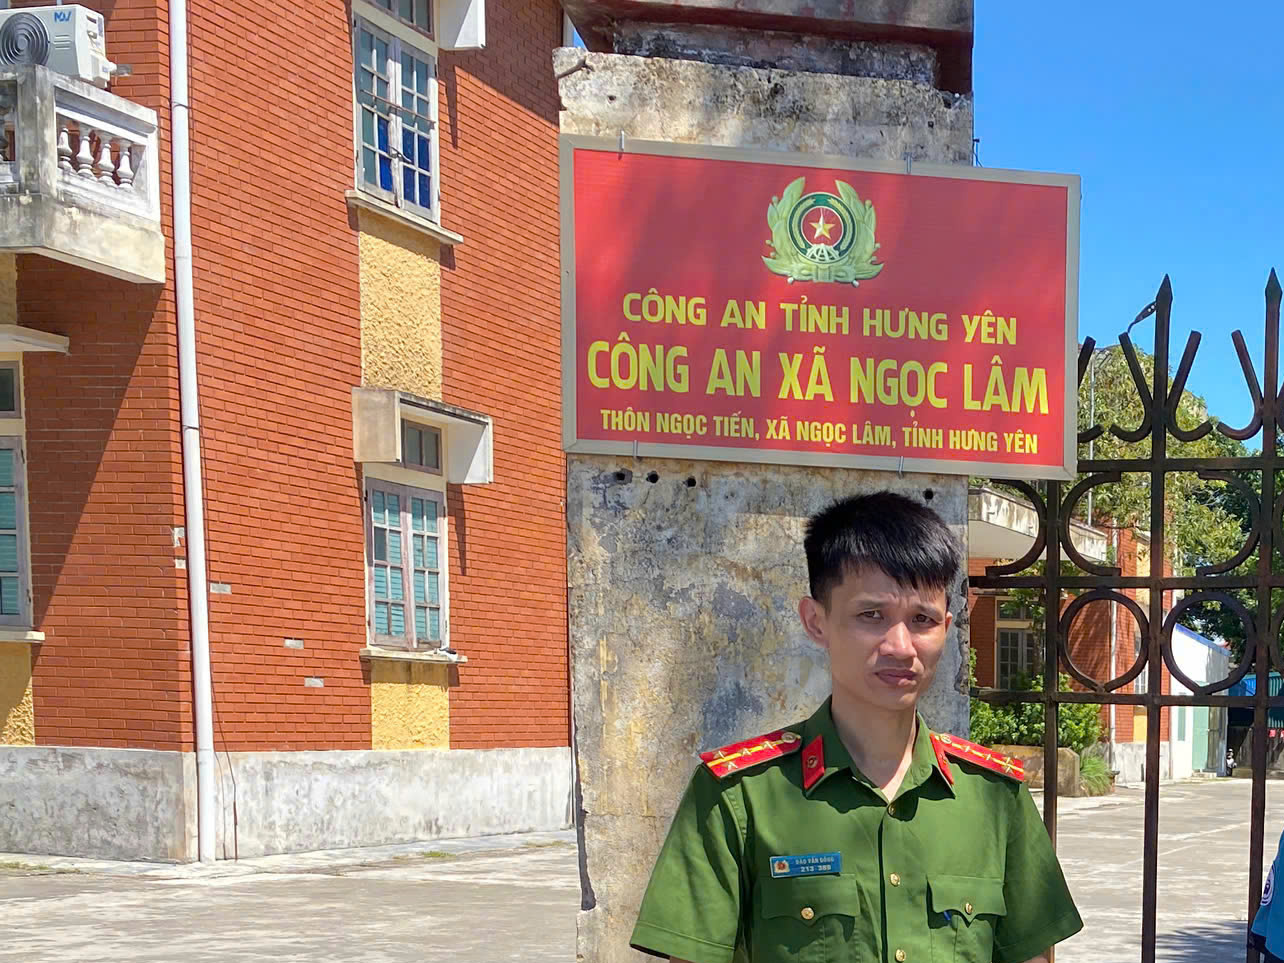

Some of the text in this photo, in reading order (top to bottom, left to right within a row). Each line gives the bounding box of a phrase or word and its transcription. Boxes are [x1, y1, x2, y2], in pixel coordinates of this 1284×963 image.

[623, 288, 1017, 345] CÔNG AN TỈNH HƯNG YÊN
[587, 332, 1049, 418] CÔNG AN XÃ NGỌC LÂM
[600, 407, 1038, 454] THÔN NGỌC TIẾN, XÃ NGỌC LÂM, TỈNH HƯNG YÊN
[800, 865, 814, 873] 213
